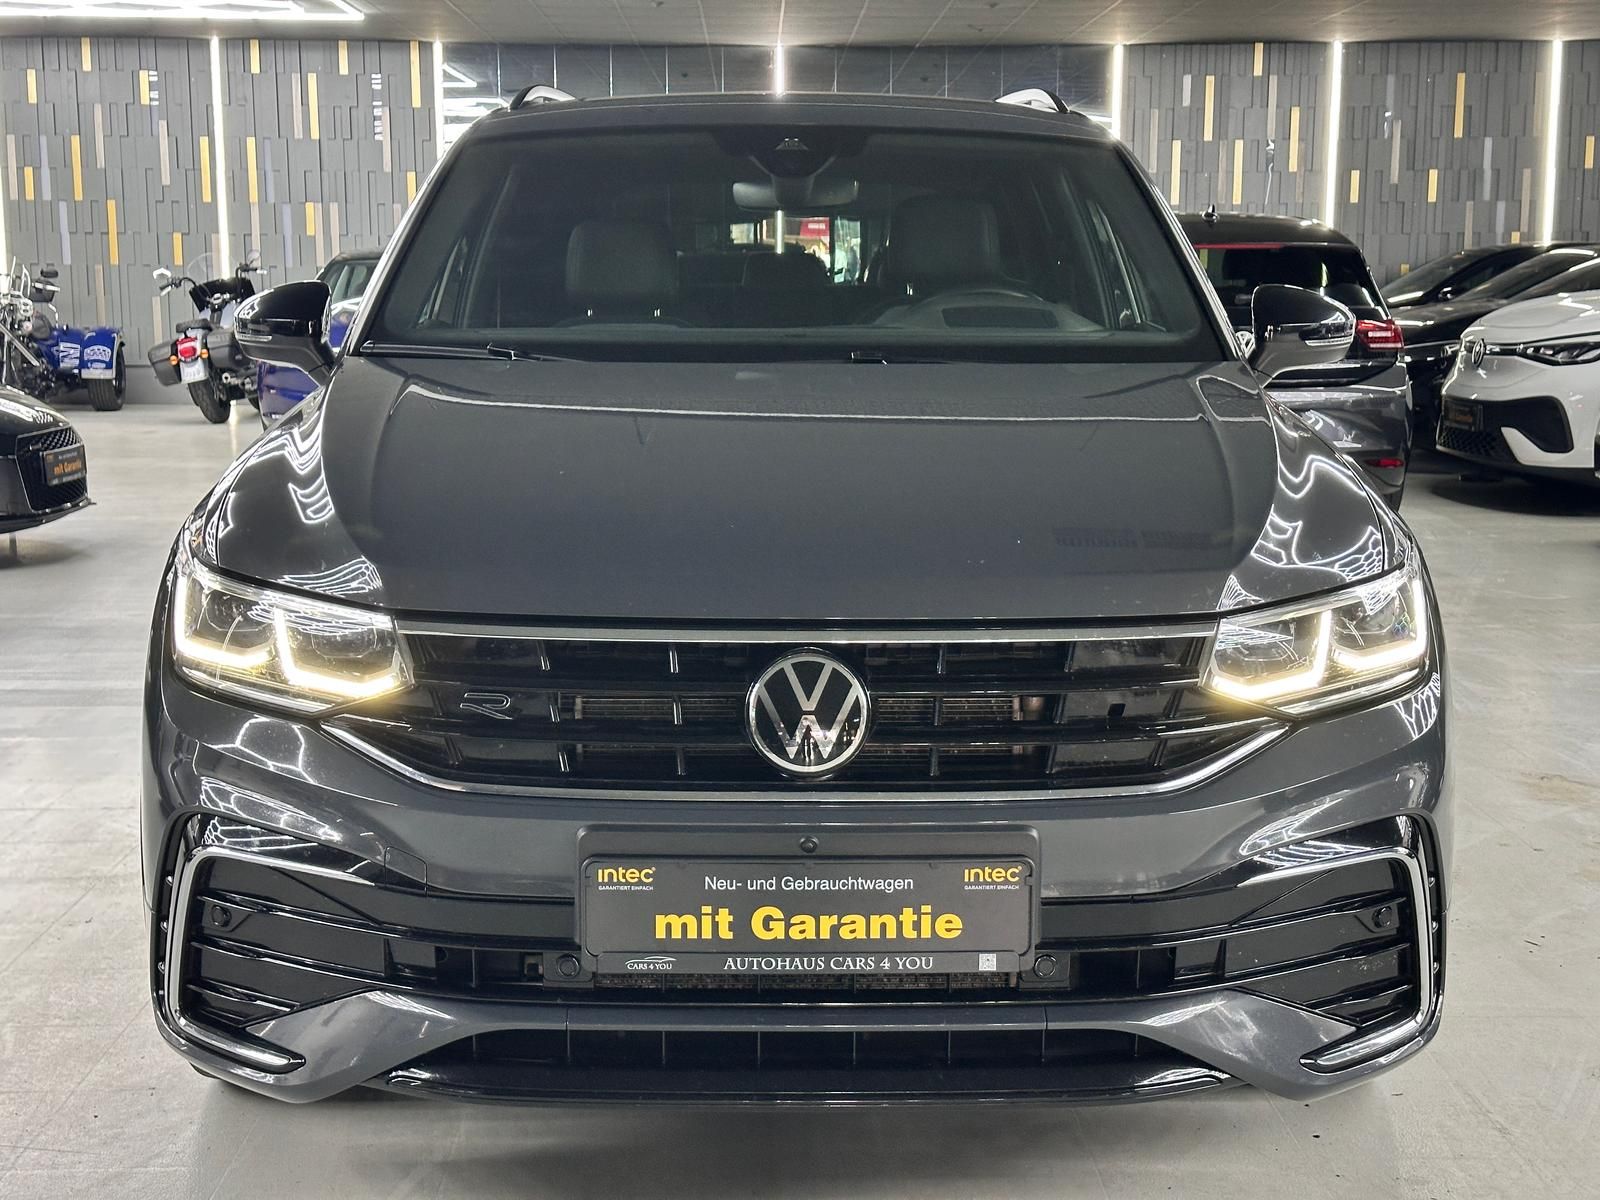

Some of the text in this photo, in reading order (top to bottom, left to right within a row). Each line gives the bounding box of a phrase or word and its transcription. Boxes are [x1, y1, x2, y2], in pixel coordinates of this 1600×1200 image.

[597, 866, 655, 883] intec
[964, 866, 1021, 882] intec
[704, 876, 914, 893] Neu- und Gebrauchtwagen
[655, 905, 963, 940] mit Garantie
[723, 956, 934, 970] AUTOHAUS CARS 4 YOU
